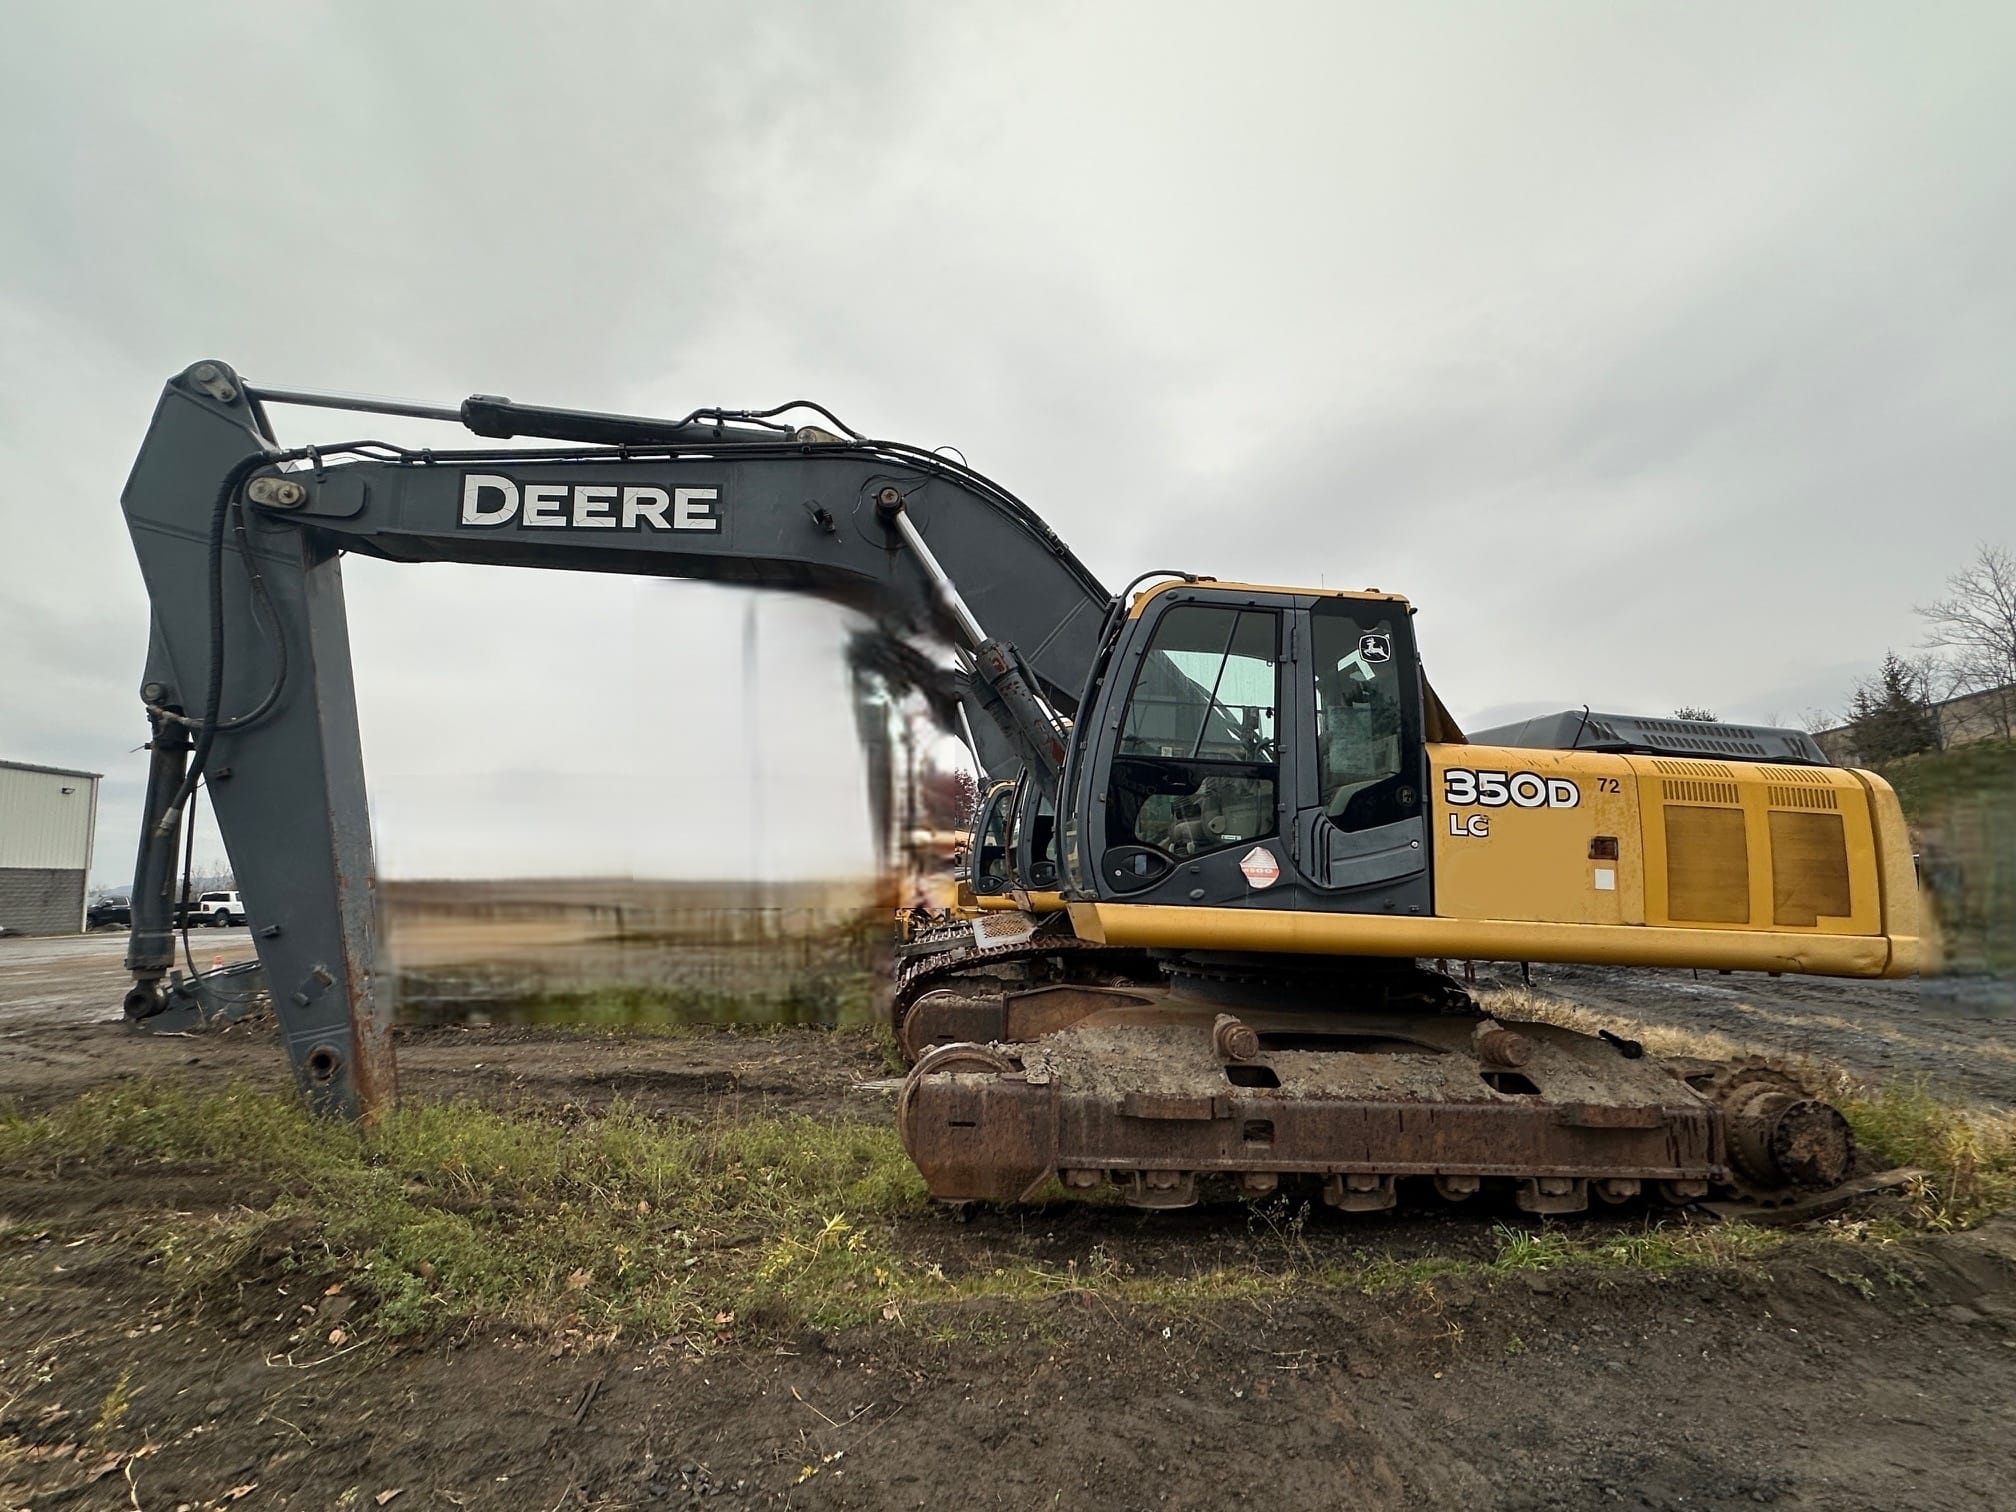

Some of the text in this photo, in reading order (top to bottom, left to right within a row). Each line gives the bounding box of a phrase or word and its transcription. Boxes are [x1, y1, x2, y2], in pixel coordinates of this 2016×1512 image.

[461, 473, 718, 530] DEERE
[1444, 768, 1580, 808] 350D
[1597, 777, 1621, 794] 72
[1449, 813, 1490, 837] LC
